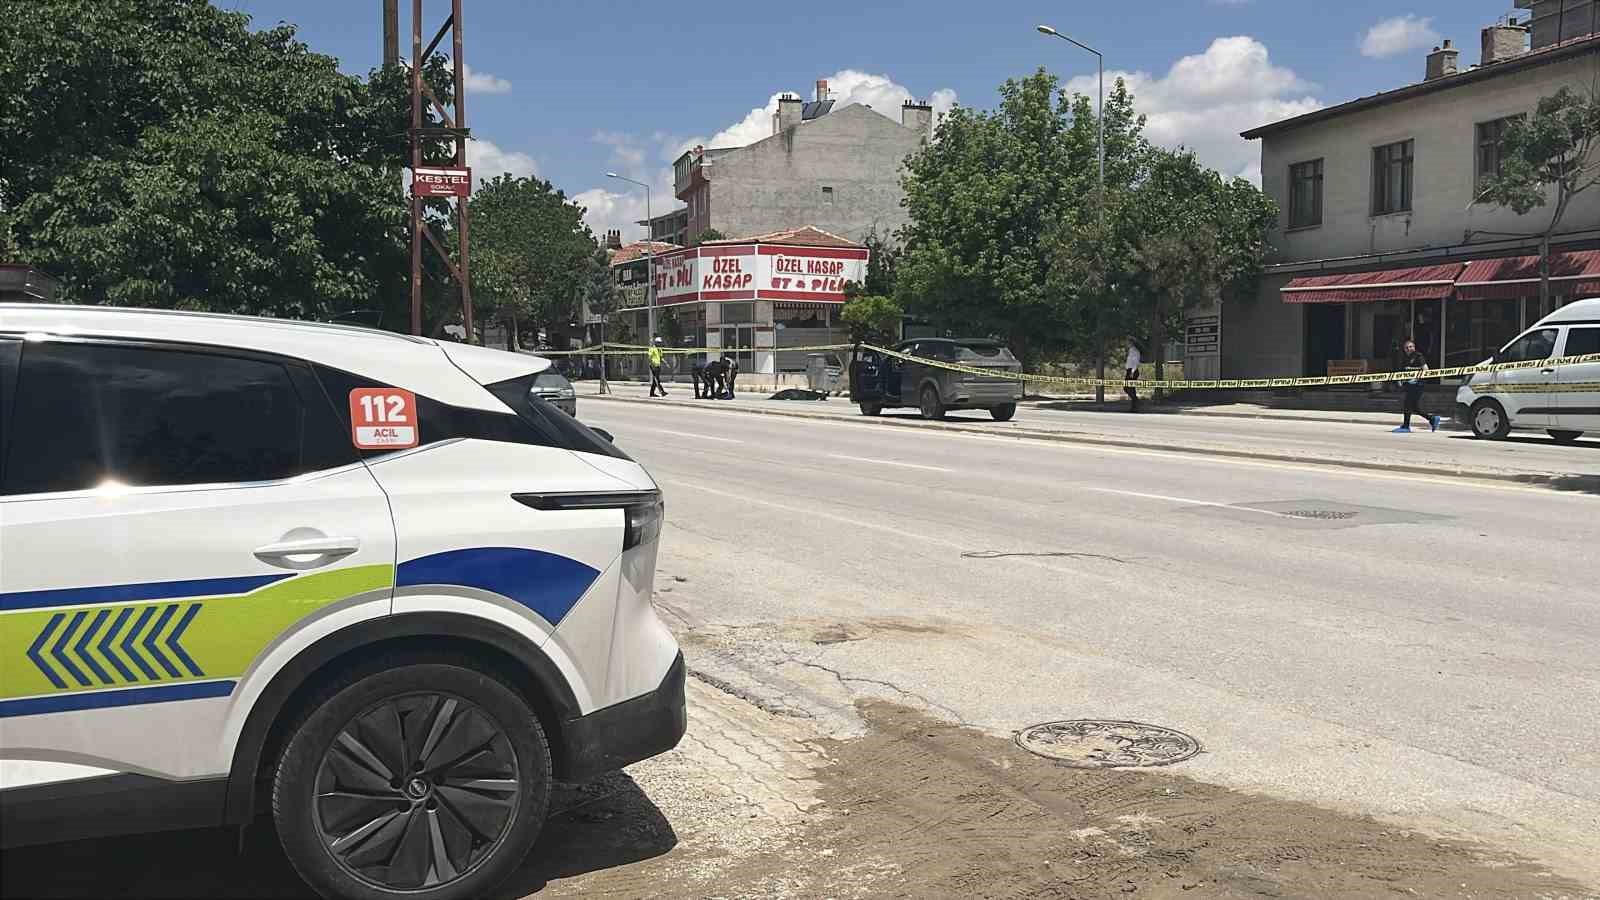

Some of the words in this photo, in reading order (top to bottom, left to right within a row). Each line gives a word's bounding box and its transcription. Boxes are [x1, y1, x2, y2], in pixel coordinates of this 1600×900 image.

[415, 174, 469, 184] KESTEL
[713, 255, 742, 273] ÖZEL
[776, 255, 803, 273] ÖZEL
[807, 260, 844, 274] KASAP
[703, 274, 753, 289] KASAP
[770, 277, 791, 289] ET
[360, 395, 407, 422] 112
